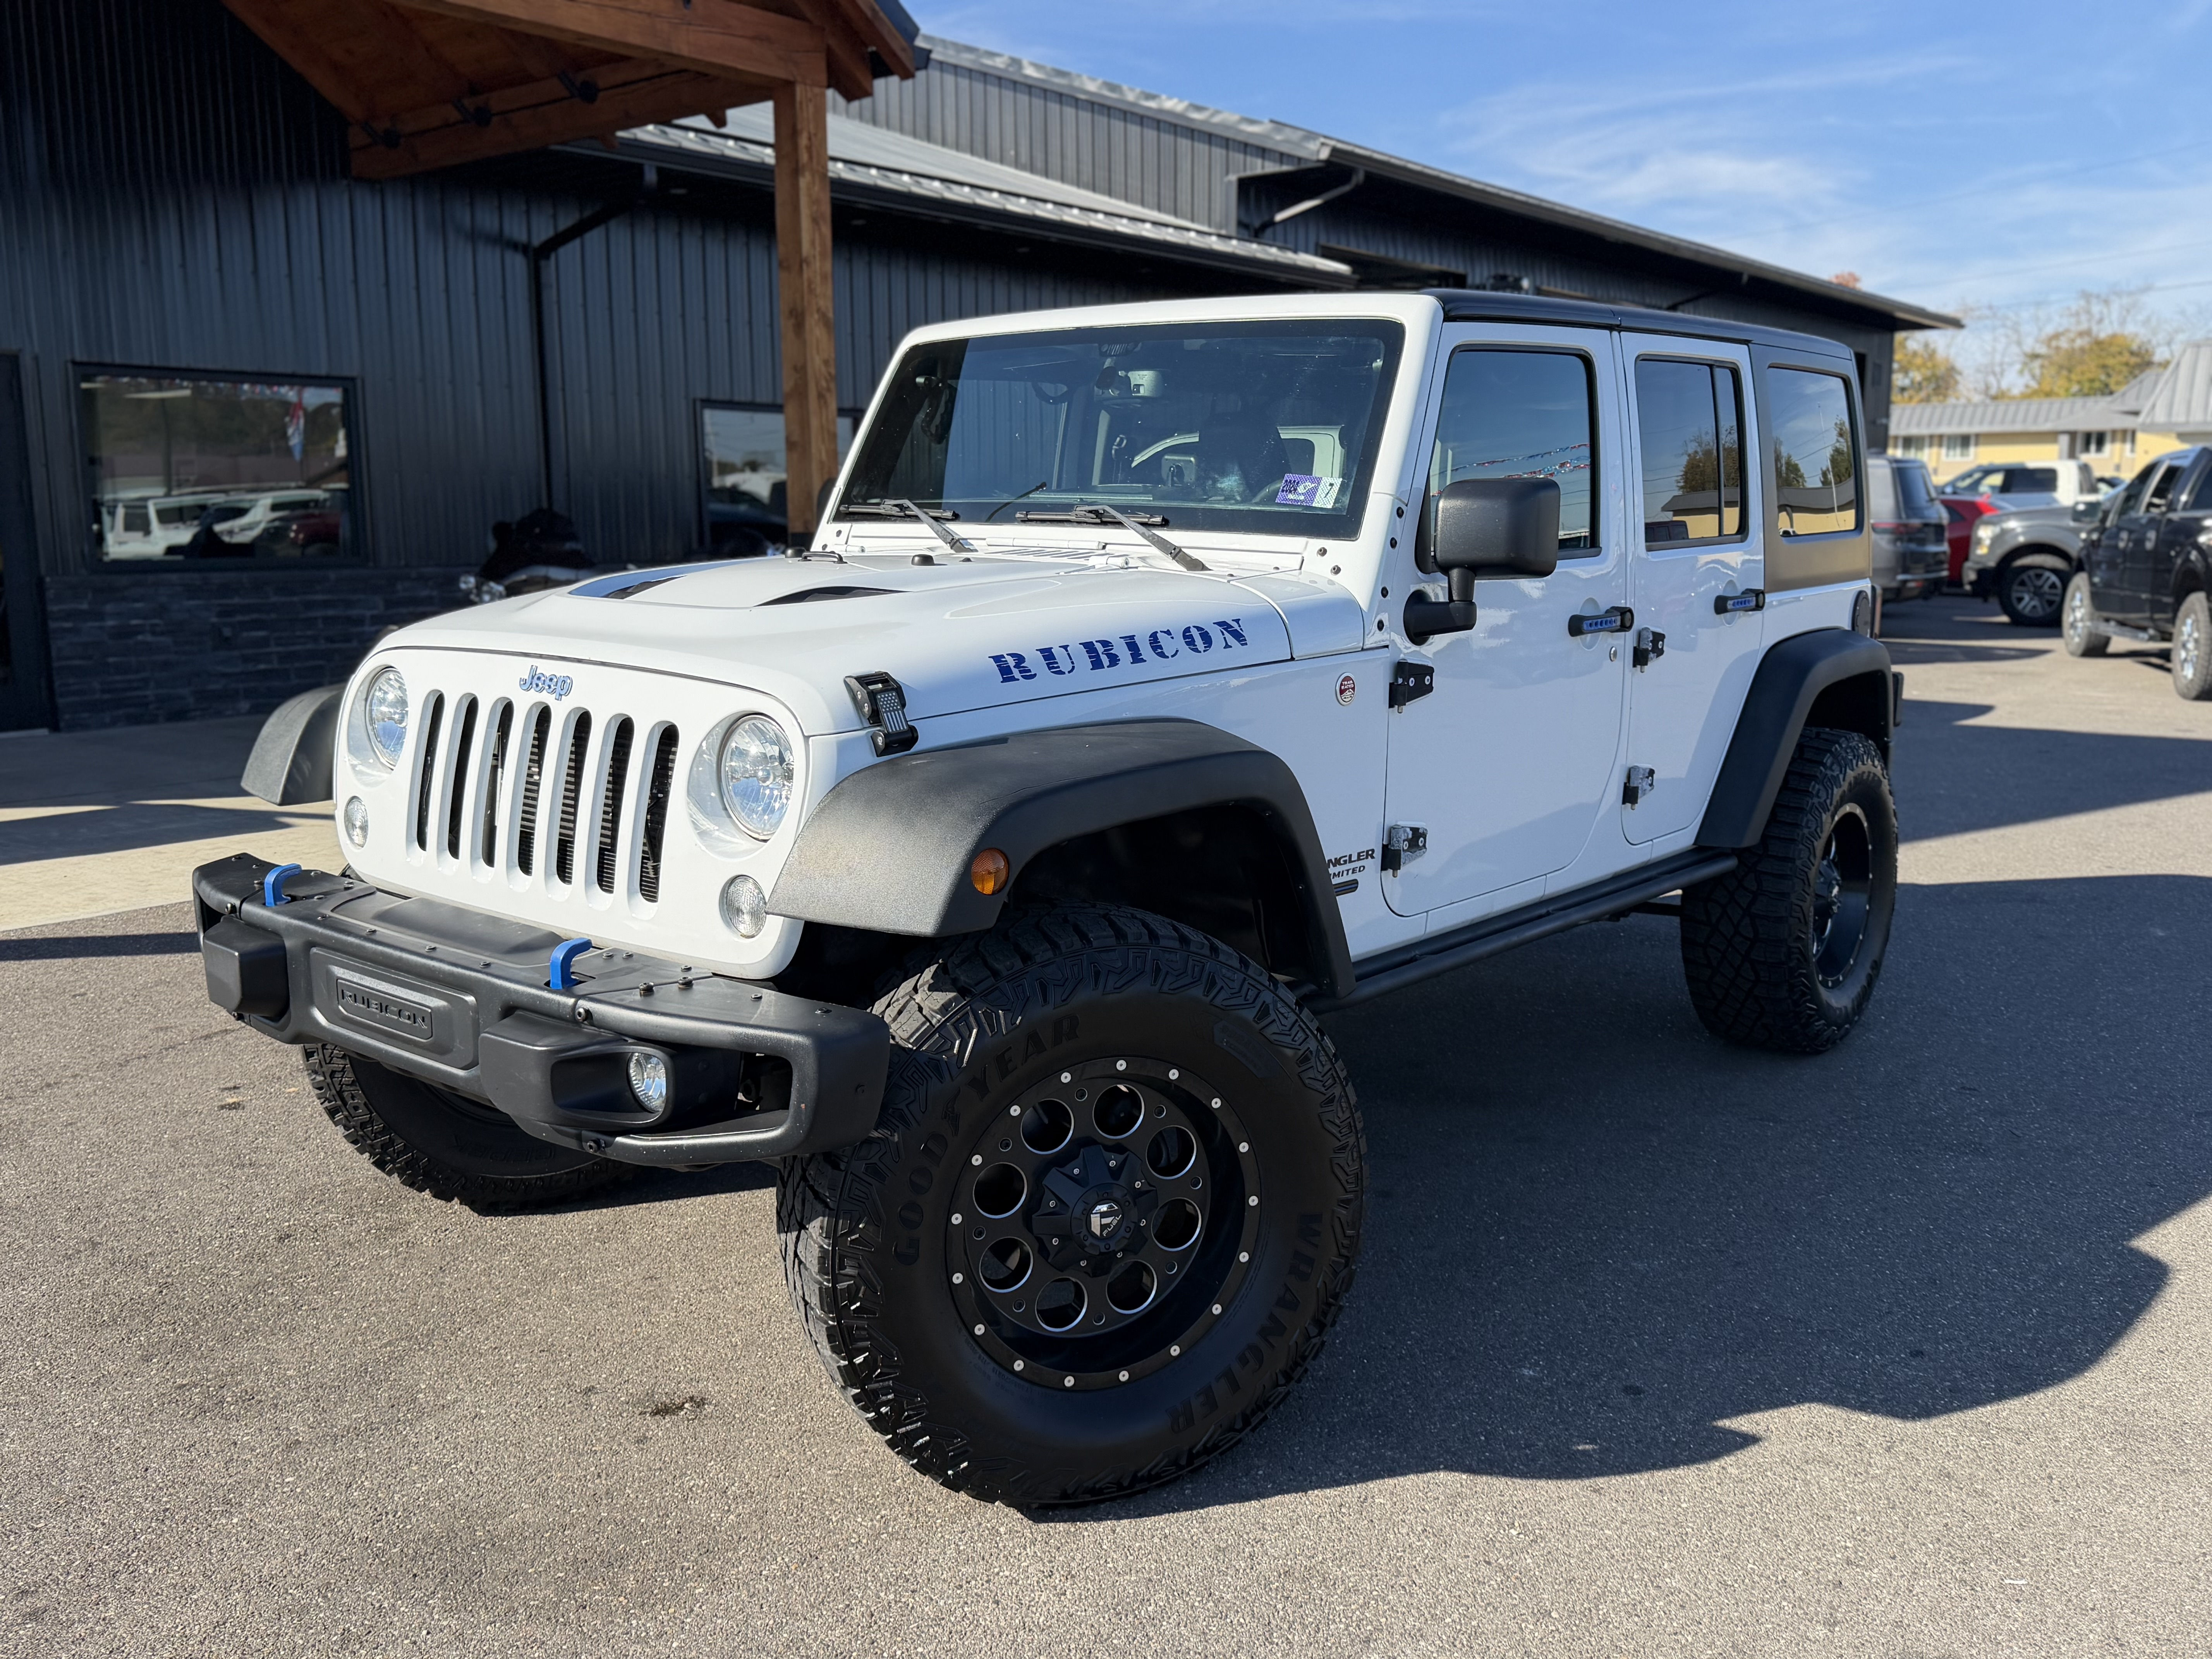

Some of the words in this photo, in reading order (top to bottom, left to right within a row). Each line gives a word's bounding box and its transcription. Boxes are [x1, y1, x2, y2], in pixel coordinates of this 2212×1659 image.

[988, 618, 1249, 684] RUBICON
[519, 665, 573, 701] Jeep
[341, 989, 428, 1029] RUBICON
[1102, 1214, 1122, 1237] FUEL
[1165, 1212, 1323, 1434] WRANGLER
